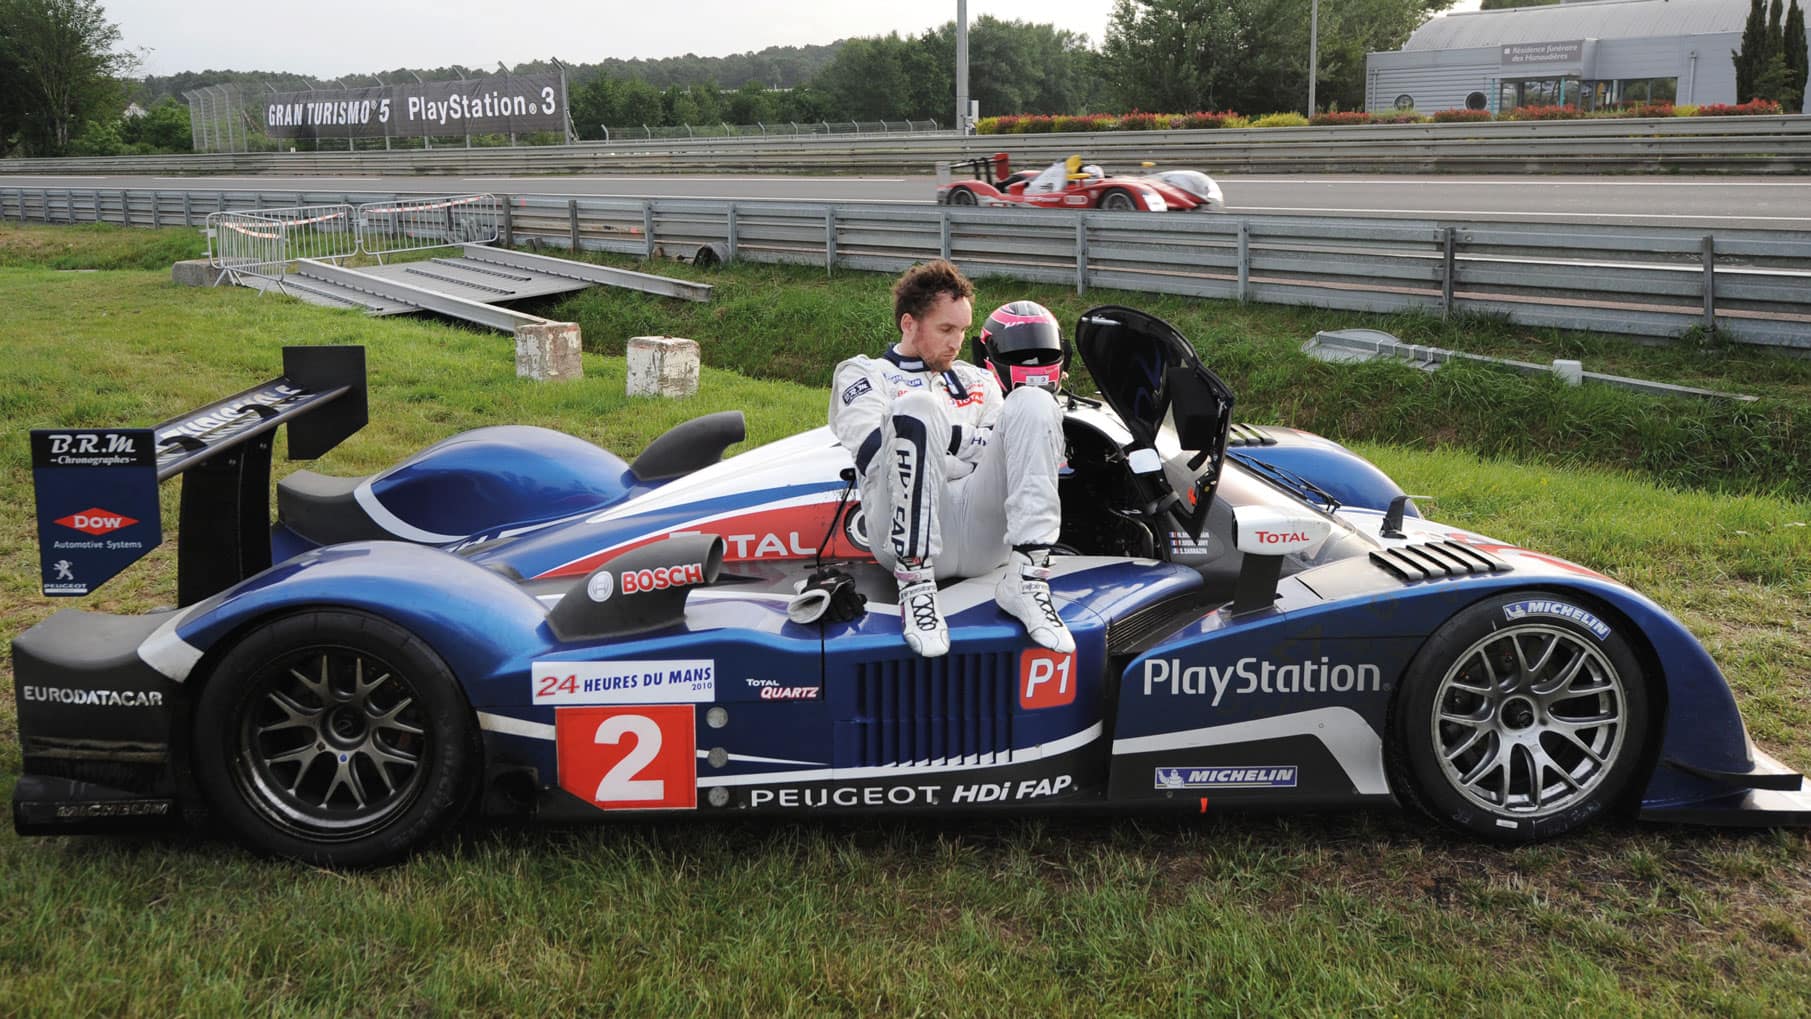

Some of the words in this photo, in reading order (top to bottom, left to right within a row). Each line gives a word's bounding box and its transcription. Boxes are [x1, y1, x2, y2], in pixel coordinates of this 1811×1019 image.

[268, 103, 302, 126] GRAN
[379, 99, 390, 123] 5
[541, 86, 555, 115] 3
[54, 541, 103, 549] Automotive
[106, 540, 142, 550] Systems
[891, 506, 906, 558] FAP
[1255, 531, 1310, 544] TOTAL
[621, 564, 704, 595] BOSCH
[1527, 602, 1608, 636] MICHELIN
[535, 674, 580, 698] 24
[583, 674, 638, 692] HEURES
[643, 672, 663, 686] DU
[668, 667, 712, 685] MANS
[692, 682, 712, 691] 2010
[745, 678, 780, 688] TOTAL
[1026, 655, 1071, 698] P1
[24, 685, 163, 706] EURODATACAR
[760, 686, 819, 700] QUARTZ
[594, 714, 664, 802] 2
[1188, 769, 1294, 783] MICHELIN
[751, 786, 941, 807] PEUGEOT
[952, 782, 1011, 803] HDi
[1015, 775, 1072, 799] FAP
